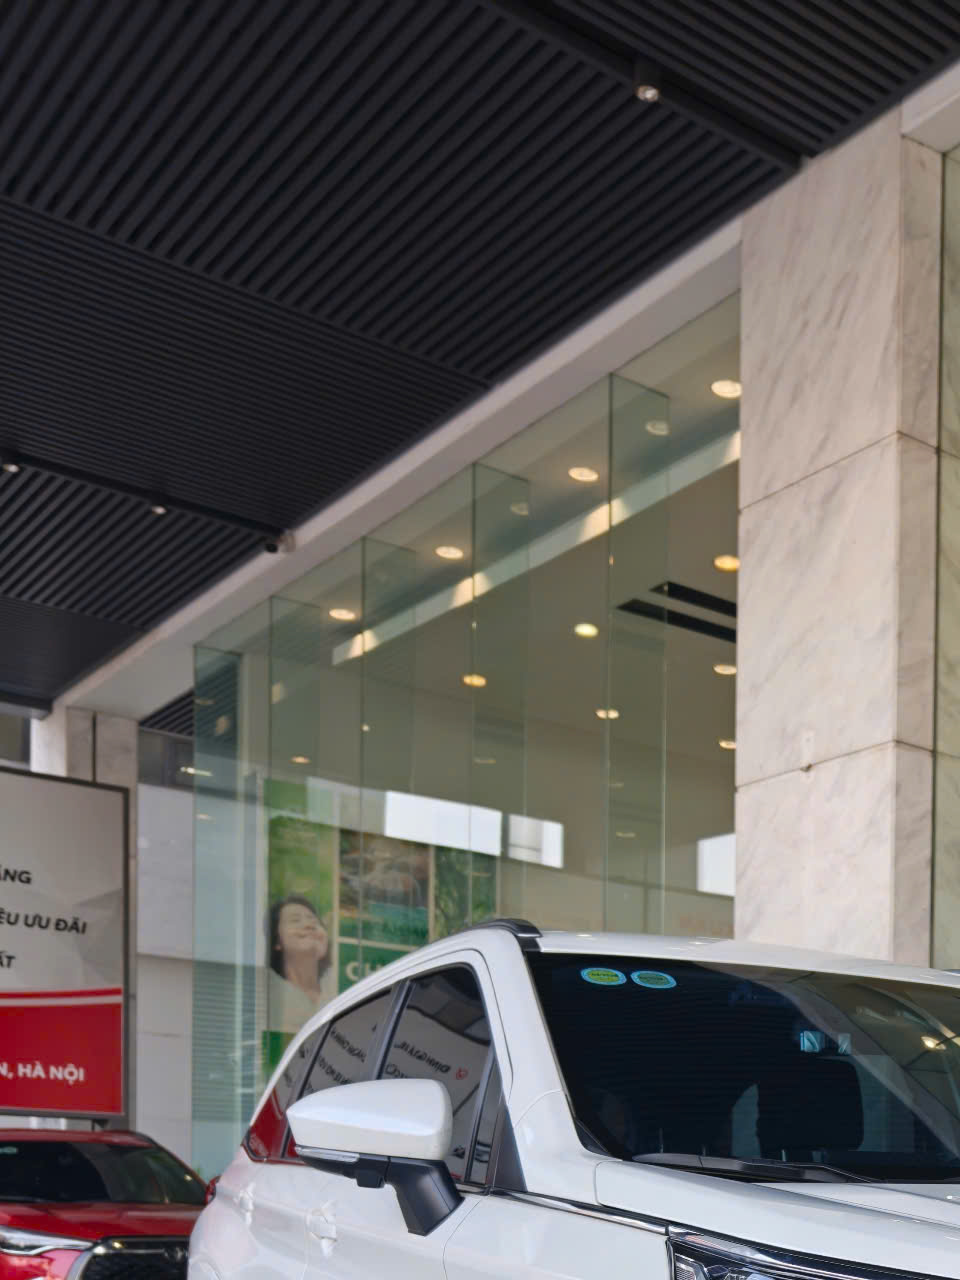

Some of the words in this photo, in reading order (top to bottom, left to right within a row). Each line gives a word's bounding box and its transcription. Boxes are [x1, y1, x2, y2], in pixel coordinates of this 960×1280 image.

[0, 864, 32, 884] NG
[55, 916, 87, 935] ĐÃI
[18, 1061, 46, 1079] HÀ
[49, 1064, 85, 1085] NỘI
